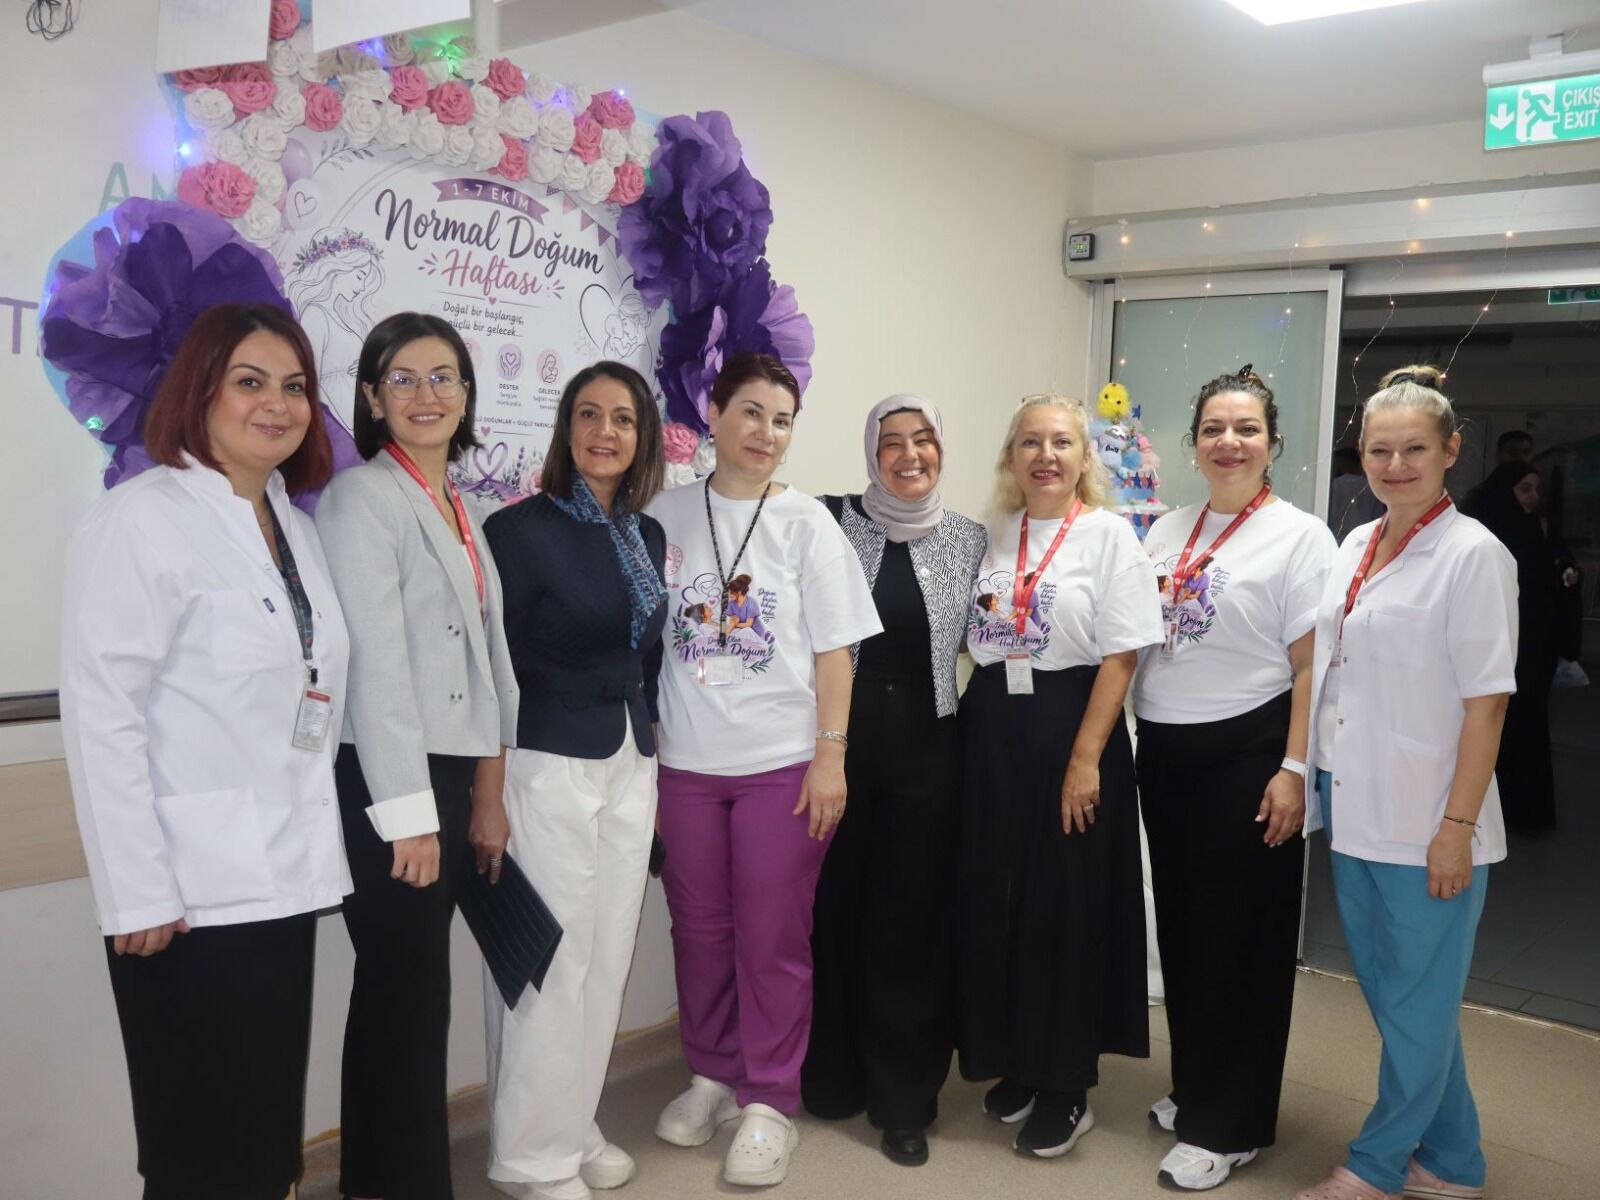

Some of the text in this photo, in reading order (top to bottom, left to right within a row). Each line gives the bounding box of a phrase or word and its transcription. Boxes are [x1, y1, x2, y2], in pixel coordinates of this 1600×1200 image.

[1564, 109, 1600, 130] EXIT
[375, 188, 604, 278] Normal Doğum
[441, 248, 542, 296] Haftası
[443, 301, 469, 317] Doğal
[470, 305, 483, 317] bir
[473, 323, 485, 332] bir
[730, 643, 769, 661] Doğum
